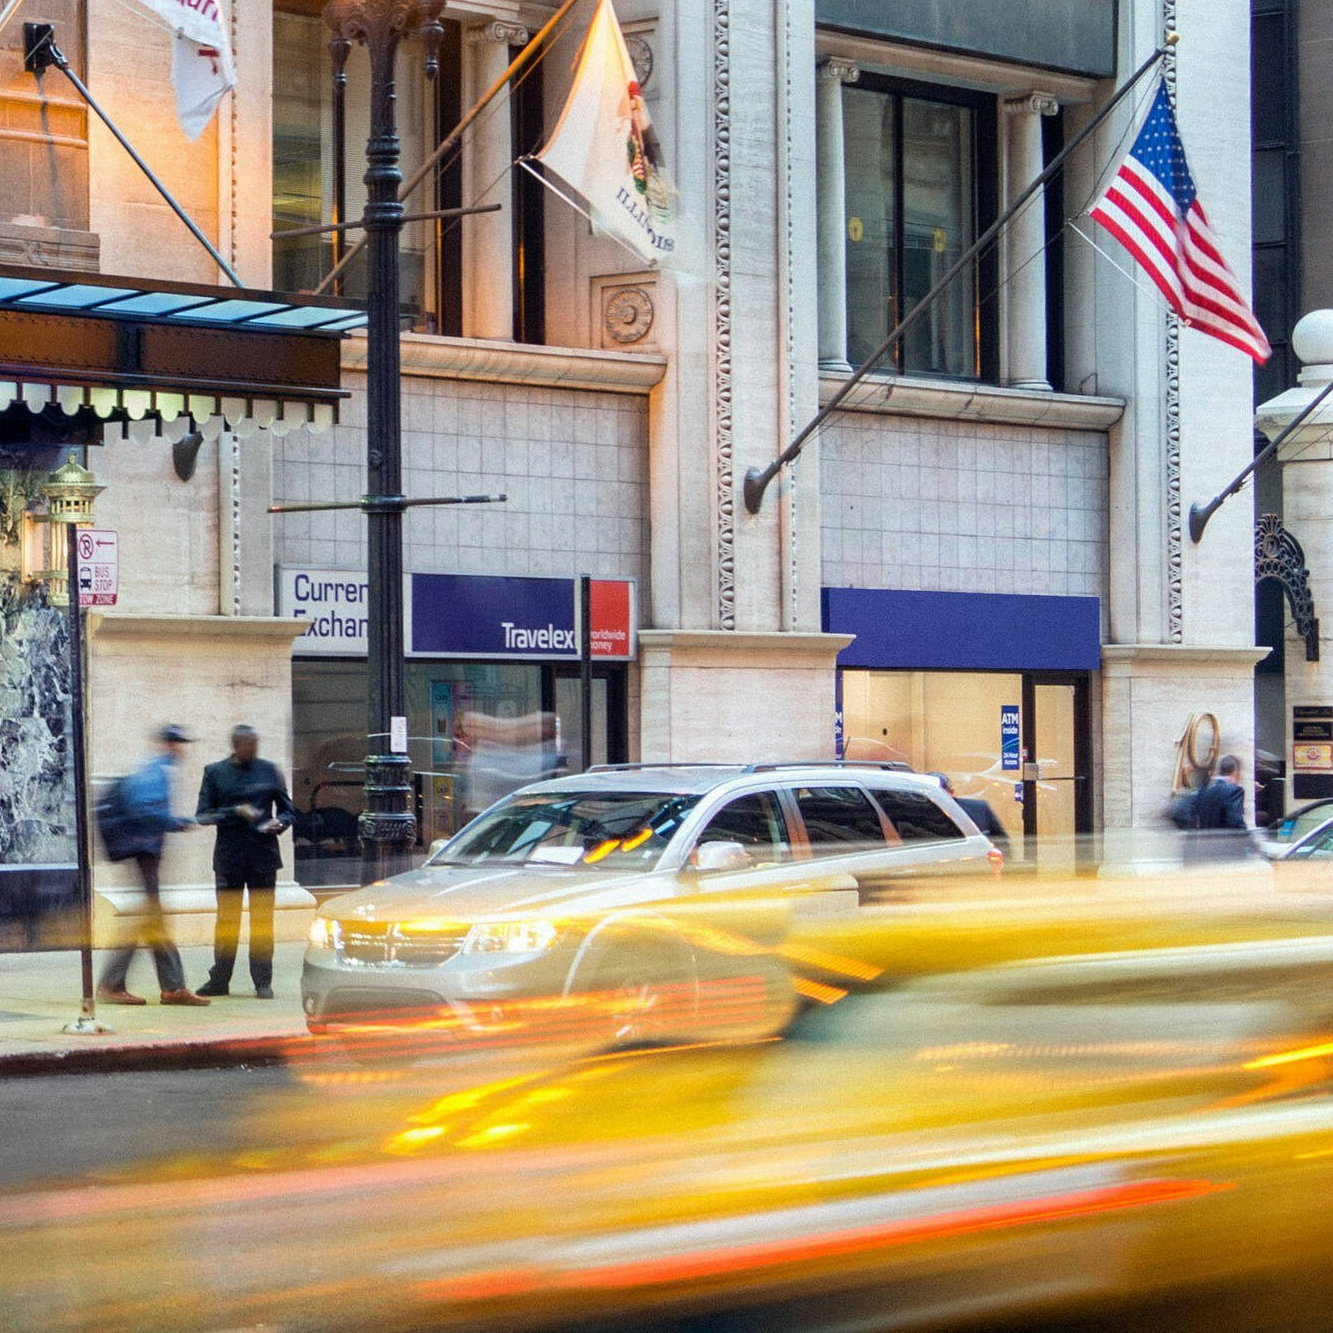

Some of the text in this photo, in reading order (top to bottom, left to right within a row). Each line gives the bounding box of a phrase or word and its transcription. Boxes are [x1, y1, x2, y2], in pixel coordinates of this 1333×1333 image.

[95, 566, 109, 578] BUS
[95, 579, 113, 591] STOP
[95, 594, 114, 605] ZONE
[294, 609, 368, 637] xchan
[501, 622, 574, 649] Travelex
[1001, 713, 1019, 725] ATM
[1002, 726, 1018, 735] inside
